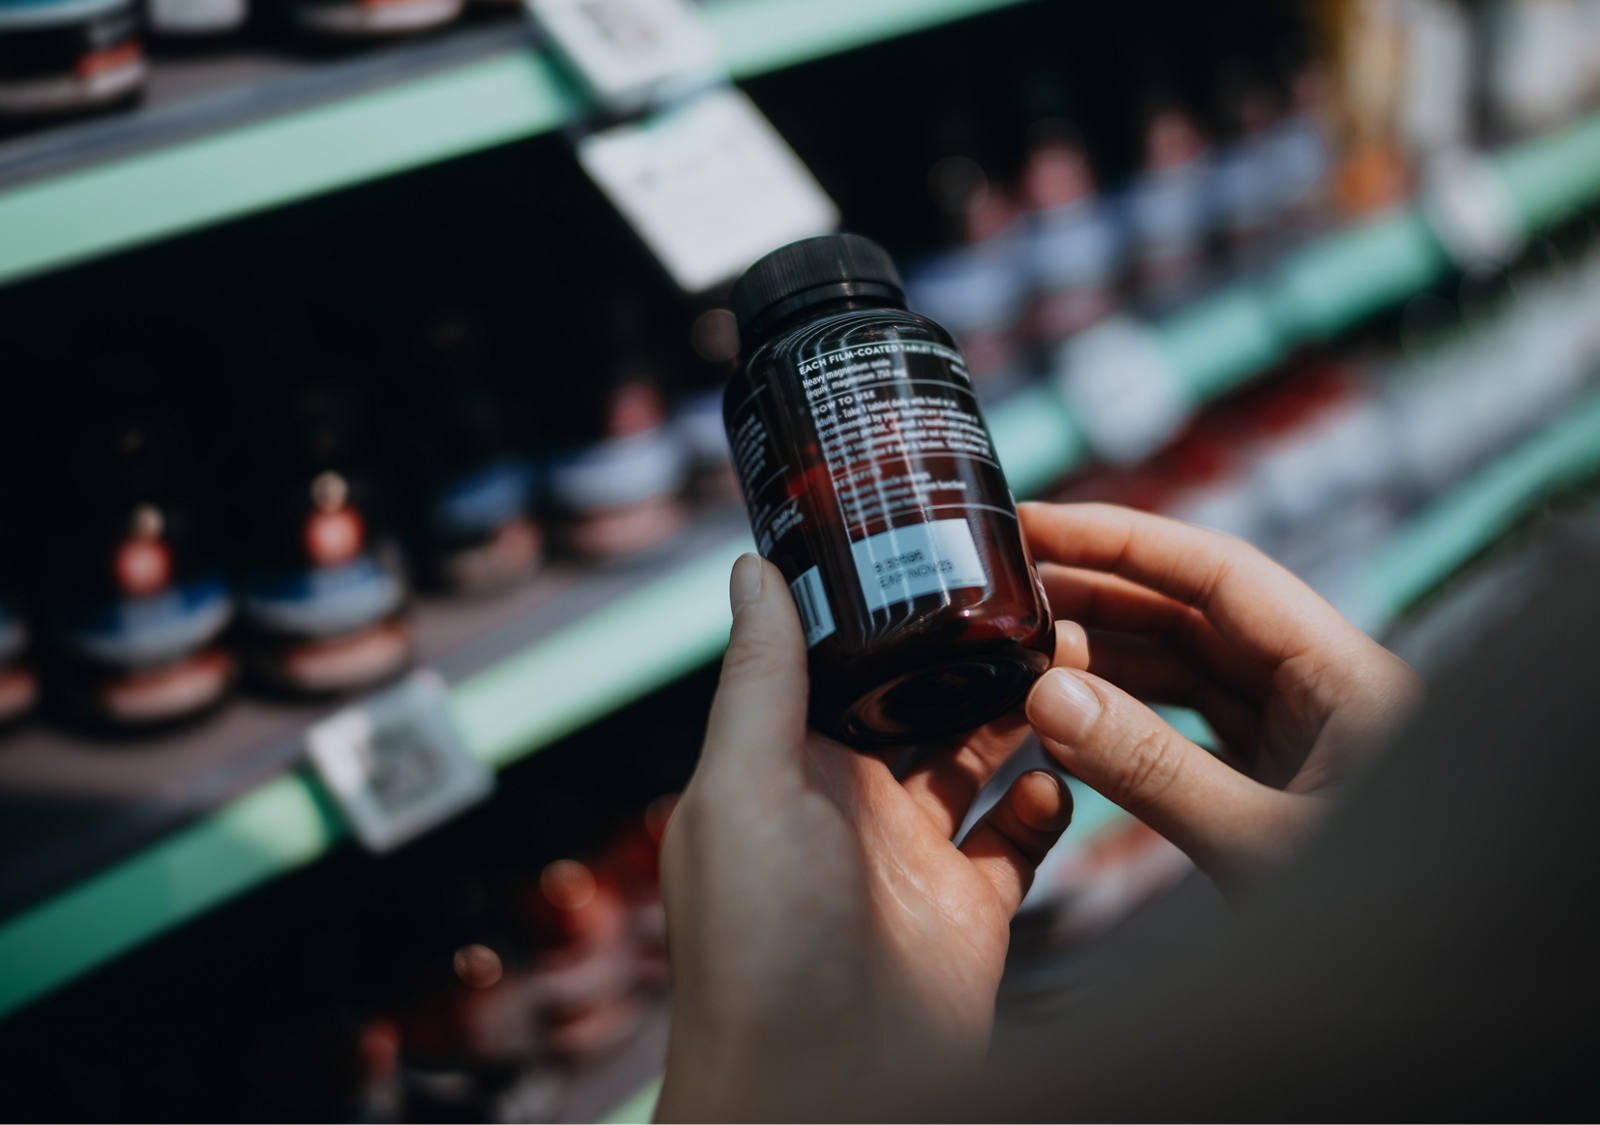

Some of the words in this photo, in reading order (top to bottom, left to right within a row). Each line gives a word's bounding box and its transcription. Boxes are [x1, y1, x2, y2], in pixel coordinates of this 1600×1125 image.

[799, 359, 827, 375] EACH
[829, 344, 898, 364] FILM-COATED
[802, 374, 826, 389] Heavy
[825, 362, 870, 381] magnesium
[811, 400, 837, 418] HOW
[838, 394, 854, 407] TO
[855, 389, 877, 402] USE
[842, 407, 862, 419] Take
